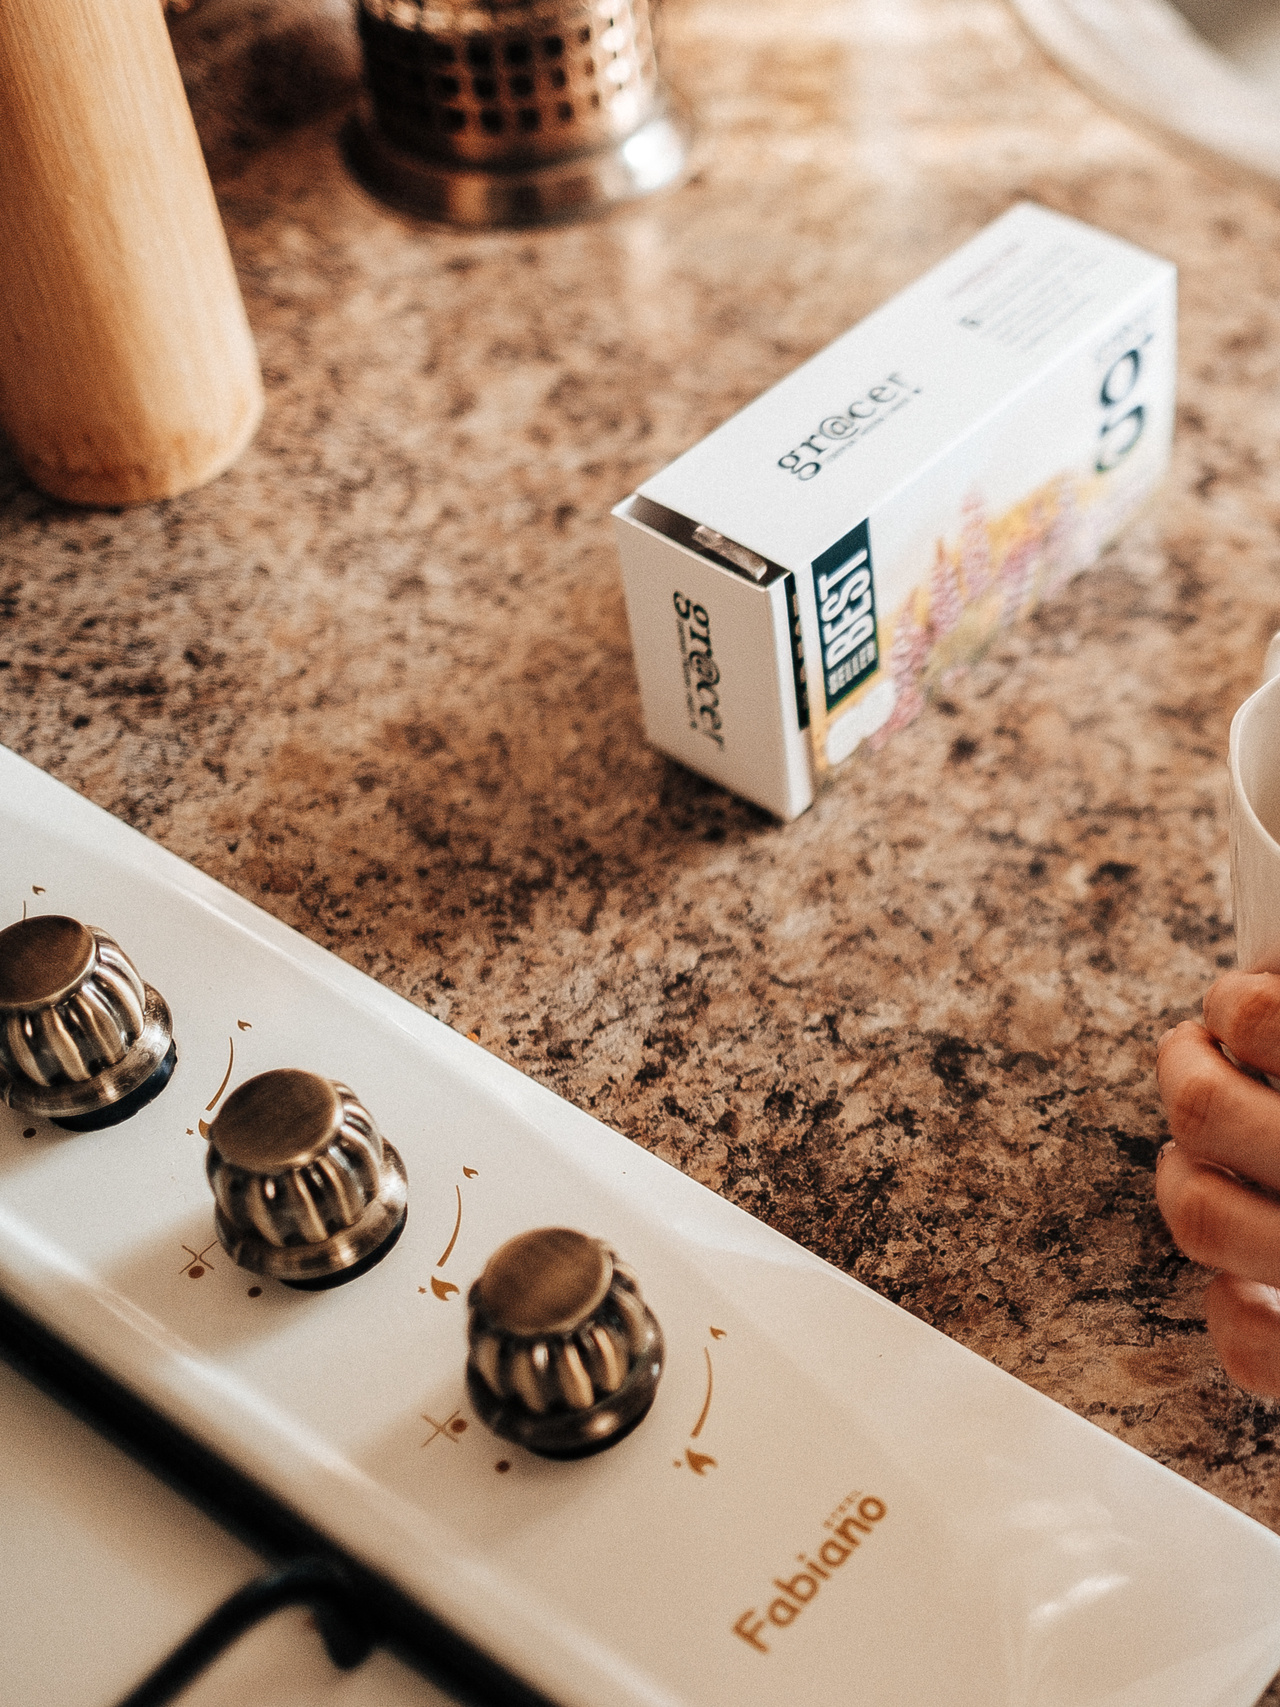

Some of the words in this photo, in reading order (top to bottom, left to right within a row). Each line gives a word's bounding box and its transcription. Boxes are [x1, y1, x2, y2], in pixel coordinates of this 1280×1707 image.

[818, 548, 875, 670] BEST
[828, 640, 877, 695] SELLER
[731, 1494, 888, 1654] Fabiano
